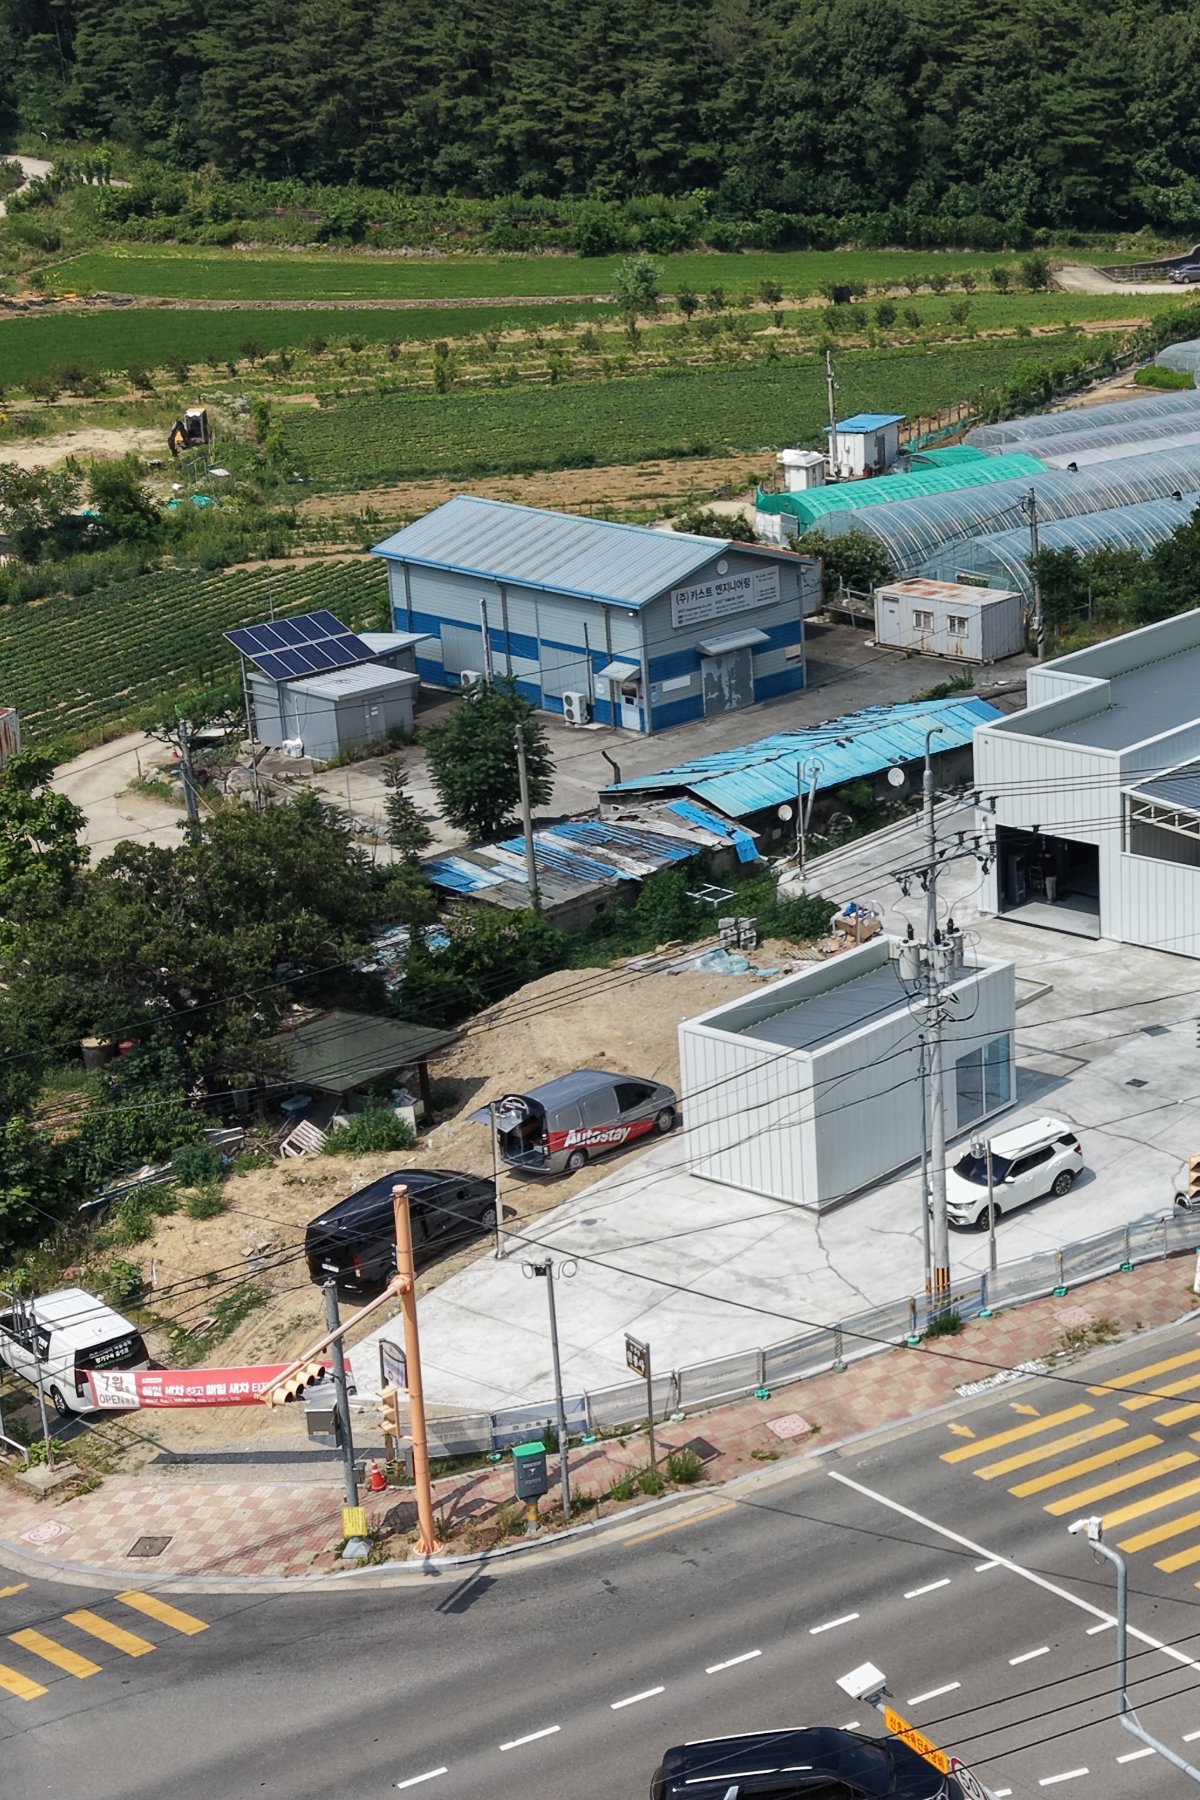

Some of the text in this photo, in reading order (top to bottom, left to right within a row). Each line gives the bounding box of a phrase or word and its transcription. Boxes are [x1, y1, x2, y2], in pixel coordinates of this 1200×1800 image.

[715, 577, 751, 595] 엔지니어링
[563, 1127, 632, 1148] Autostay
[206, 1383, 227, 1396] 매일
[229, 1382, 249, 1394] 새차
[959, 1771, 980, 1799] 50
